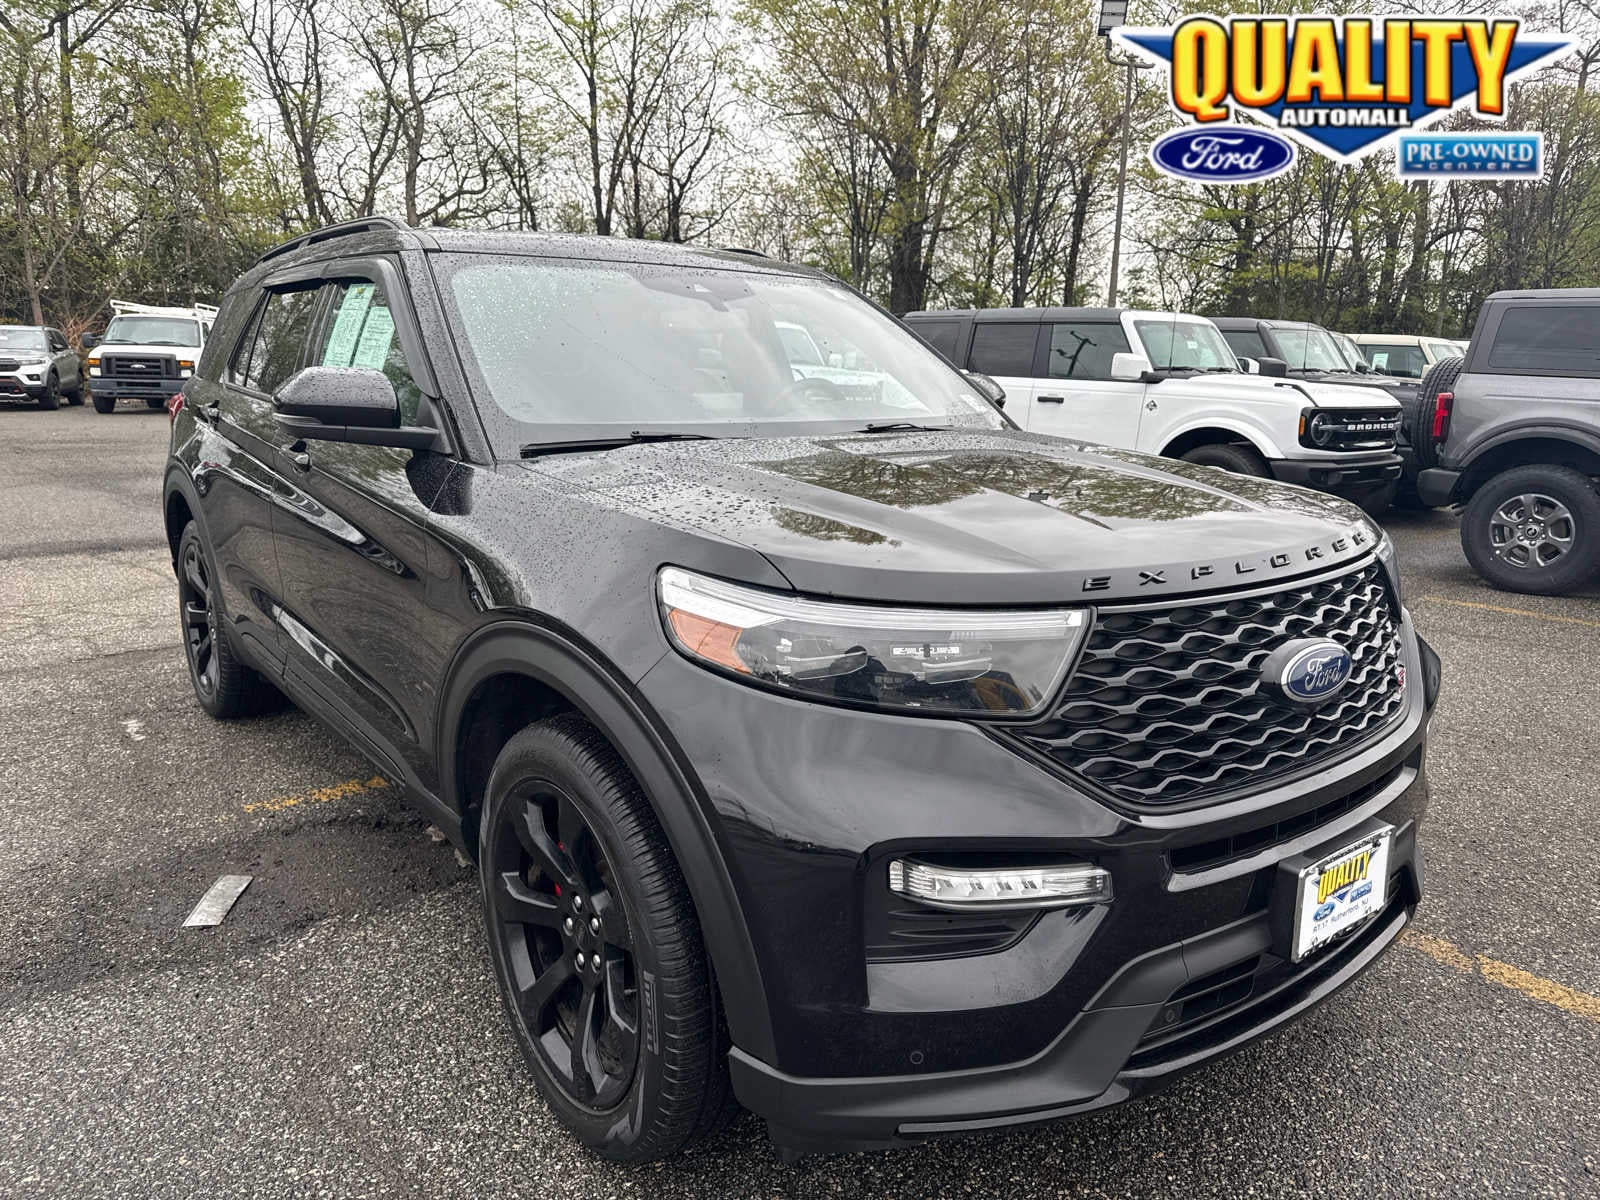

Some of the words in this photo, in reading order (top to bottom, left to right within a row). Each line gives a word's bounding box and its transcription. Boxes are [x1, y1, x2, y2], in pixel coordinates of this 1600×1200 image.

[1347, 422, 1395, 432] BRONCO
[1081, 530, 1369, 593] EXPLORER
[1304, 655, 1342, 691] Ford
[1317, 849, 1371, 904] QUALITY
